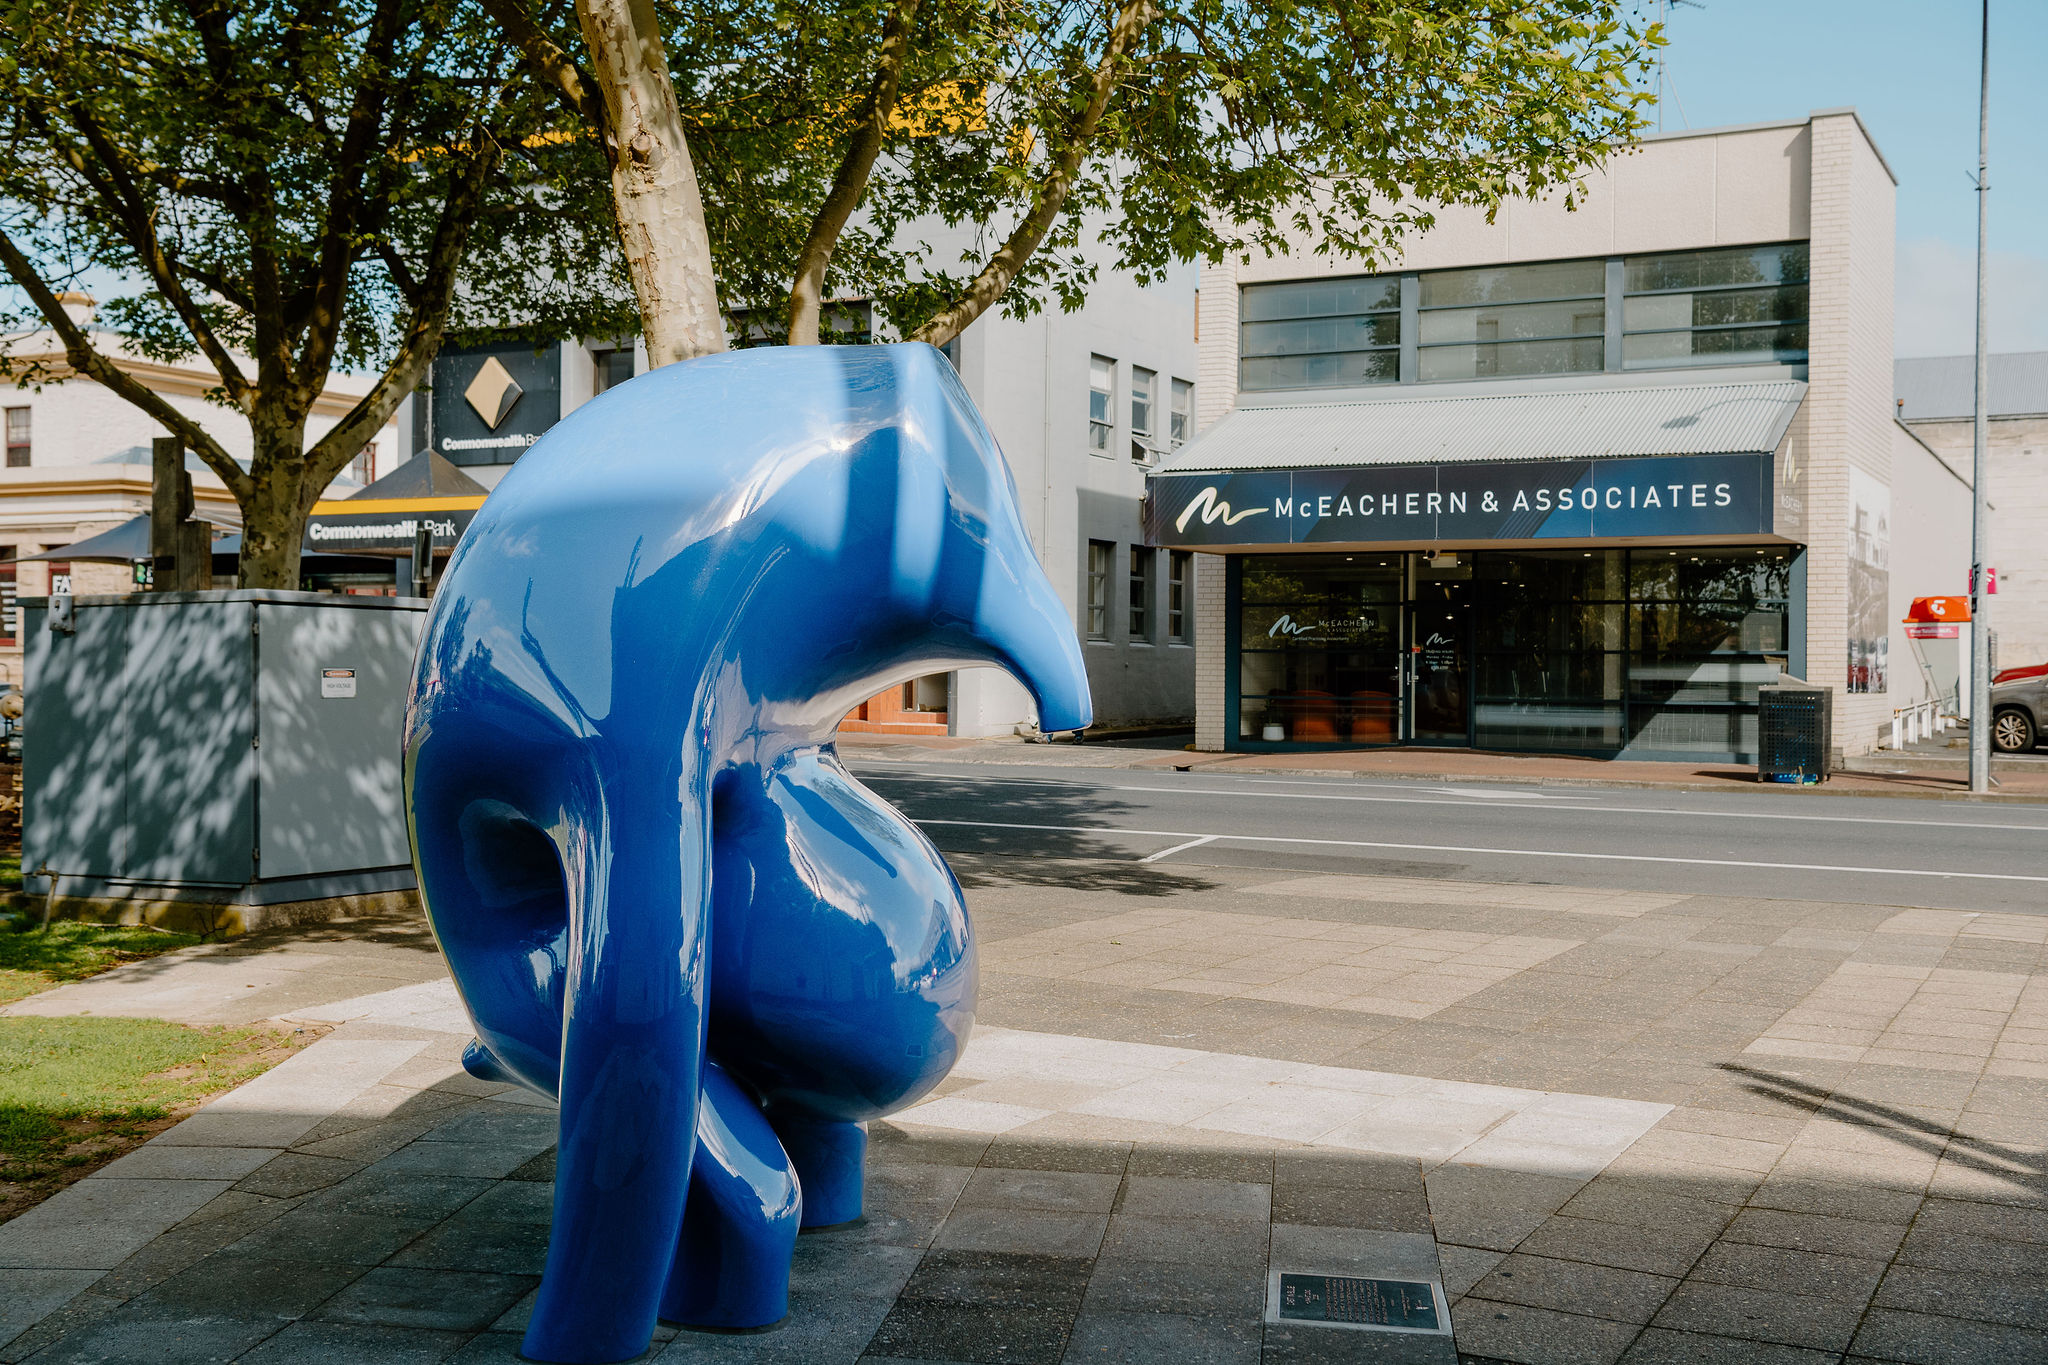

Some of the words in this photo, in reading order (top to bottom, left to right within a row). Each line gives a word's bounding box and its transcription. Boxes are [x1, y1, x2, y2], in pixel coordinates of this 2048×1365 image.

[442, 434, 525, 451] Commonwealth
[525, 433, 545, 447] Ba
[1275, 491, 1467, 518] McEACHERN
[1481, 490, 1499, 513] &
[1512, 483, 1731, 512] ASSOCIATES
[1318, 619, 1375, 627] McEACHERN
